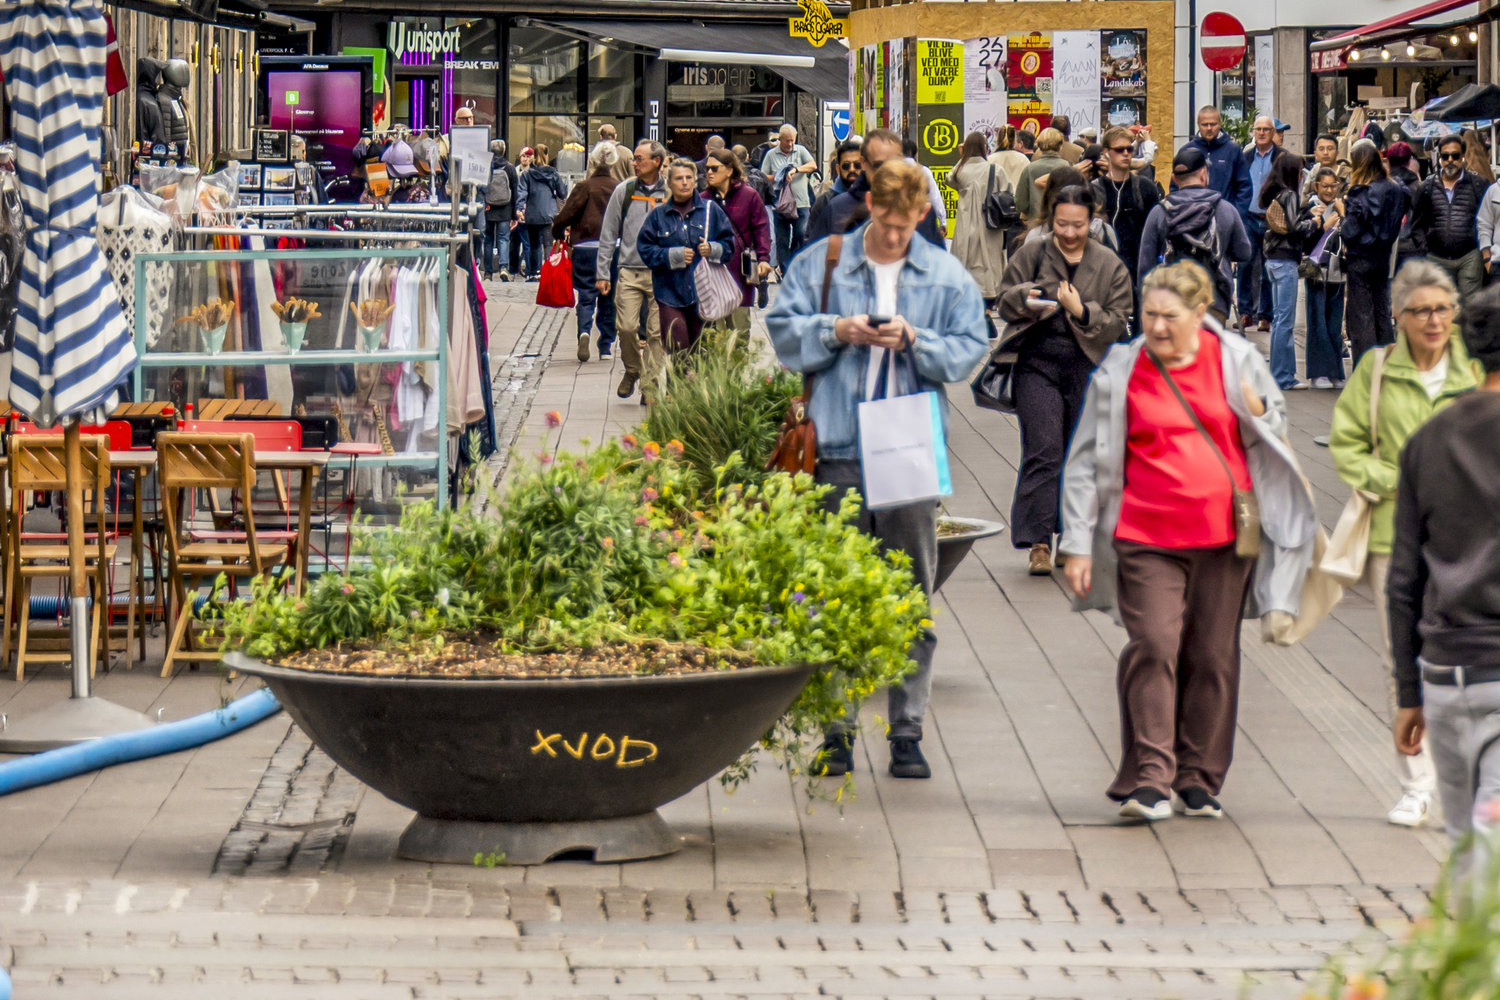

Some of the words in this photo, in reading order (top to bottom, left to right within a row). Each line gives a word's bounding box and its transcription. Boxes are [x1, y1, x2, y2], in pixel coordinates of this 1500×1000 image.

[793, 19, 815, 34] FARAOS
[815, 20, 843, 36] CIGARER
[407, 23, 461, 60] unisport
[928, 49, 953, 58] BLIVE
[978, 49, 1003, 67] 27
[444, 61, 479, 70] BREAK
[921, 58, 939, 67] VED
[940, 58, 959, 67] MED
[922, 67, 935, 76] AT
[935, 67, 959, 76] VÆRE
[928, 76, 955, 86] DUM?
[1104, 77, 1145, 88] Landskab
[530, 729, 658, 769] XVOD
